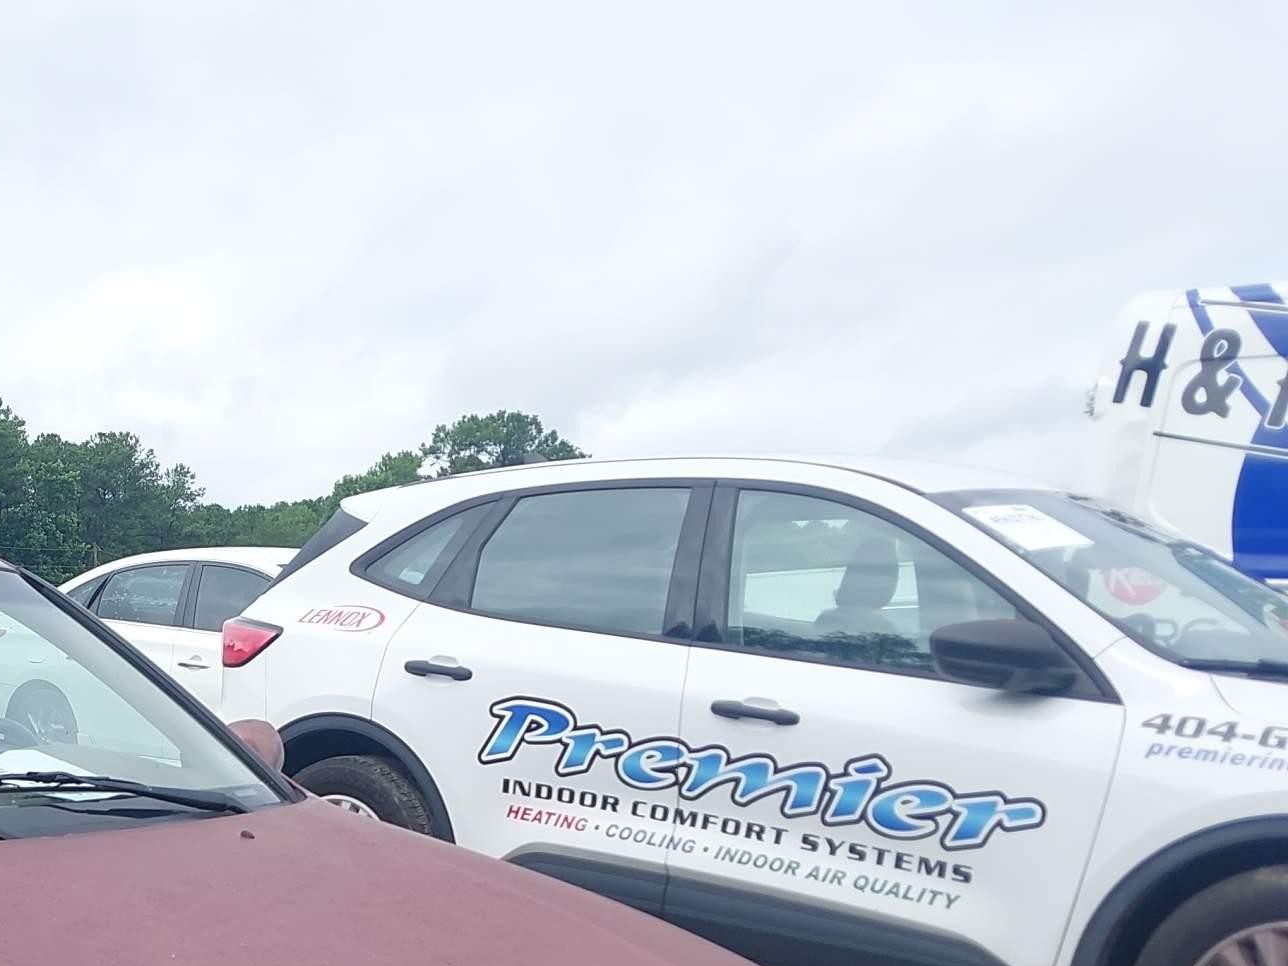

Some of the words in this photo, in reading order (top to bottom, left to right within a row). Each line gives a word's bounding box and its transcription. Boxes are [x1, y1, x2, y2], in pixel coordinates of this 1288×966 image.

[1112, 320, 1178, 408] H
[1181, 328, 1243, 419] &
[297, 608, 373, 628] LENNOX
[477, 695, 1047, 850] Premier
[1144, 742, 1288, 772] premierin
[501, 778, 620, 813] INDOOR
[631, 801, 789, 846] COMFORT
[800, 833, 974, 884] SYSTEMS
[506, 804, 589, 832] HEATING
[605, 823, 697, 854] COOLING
[713, 845, 801, 876] INDOOR
[805, 865, 847, 886] AIR
[853, 874, 961, 910] QUALITY
